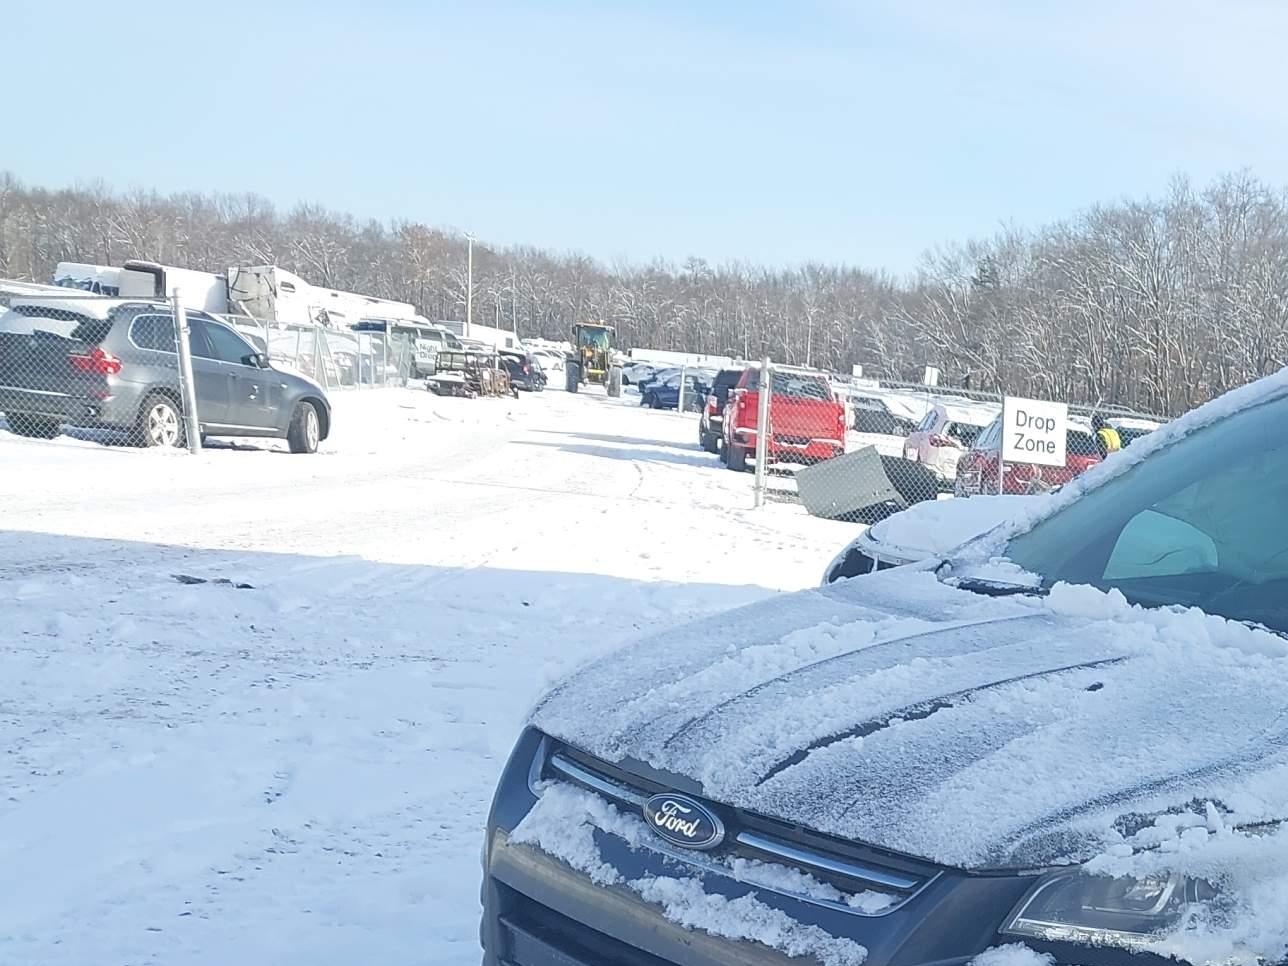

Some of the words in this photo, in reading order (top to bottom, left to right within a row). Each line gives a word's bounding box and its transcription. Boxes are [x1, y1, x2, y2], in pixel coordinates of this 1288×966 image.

[1016, 409, 1056, 434] Drop
[1014, 433, 1056, 454] Zone
[654, 800, 700, 837] Ford
